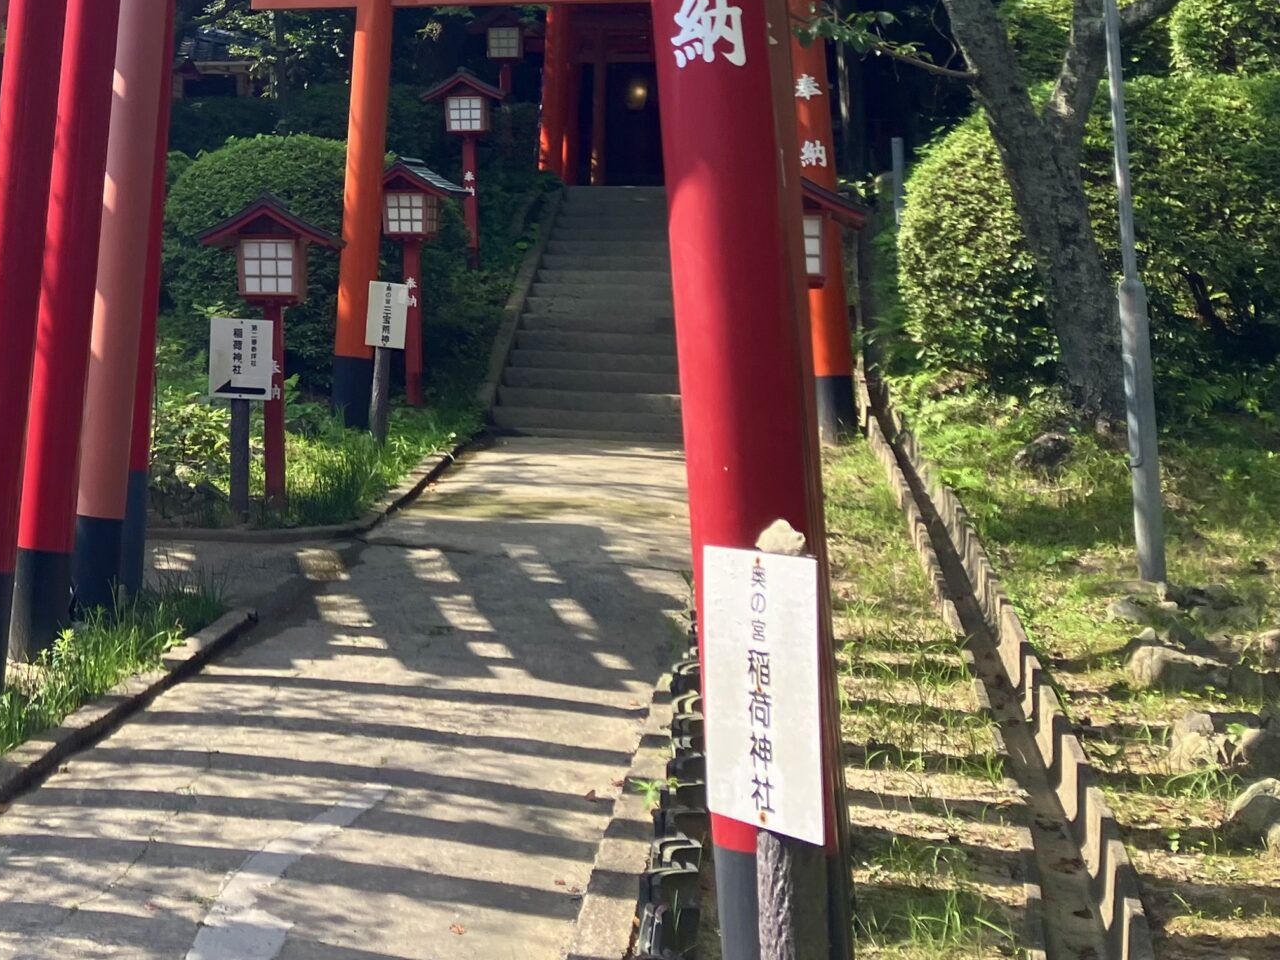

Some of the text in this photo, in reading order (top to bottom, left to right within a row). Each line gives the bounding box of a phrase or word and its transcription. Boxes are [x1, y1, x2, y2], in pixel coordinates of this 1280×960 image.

[795, 73, 827, 168] 奉納
[232, 327, 243, 375] 稲荷神社
[749, 565, 775, 814] 奥の宮稲荷神社
